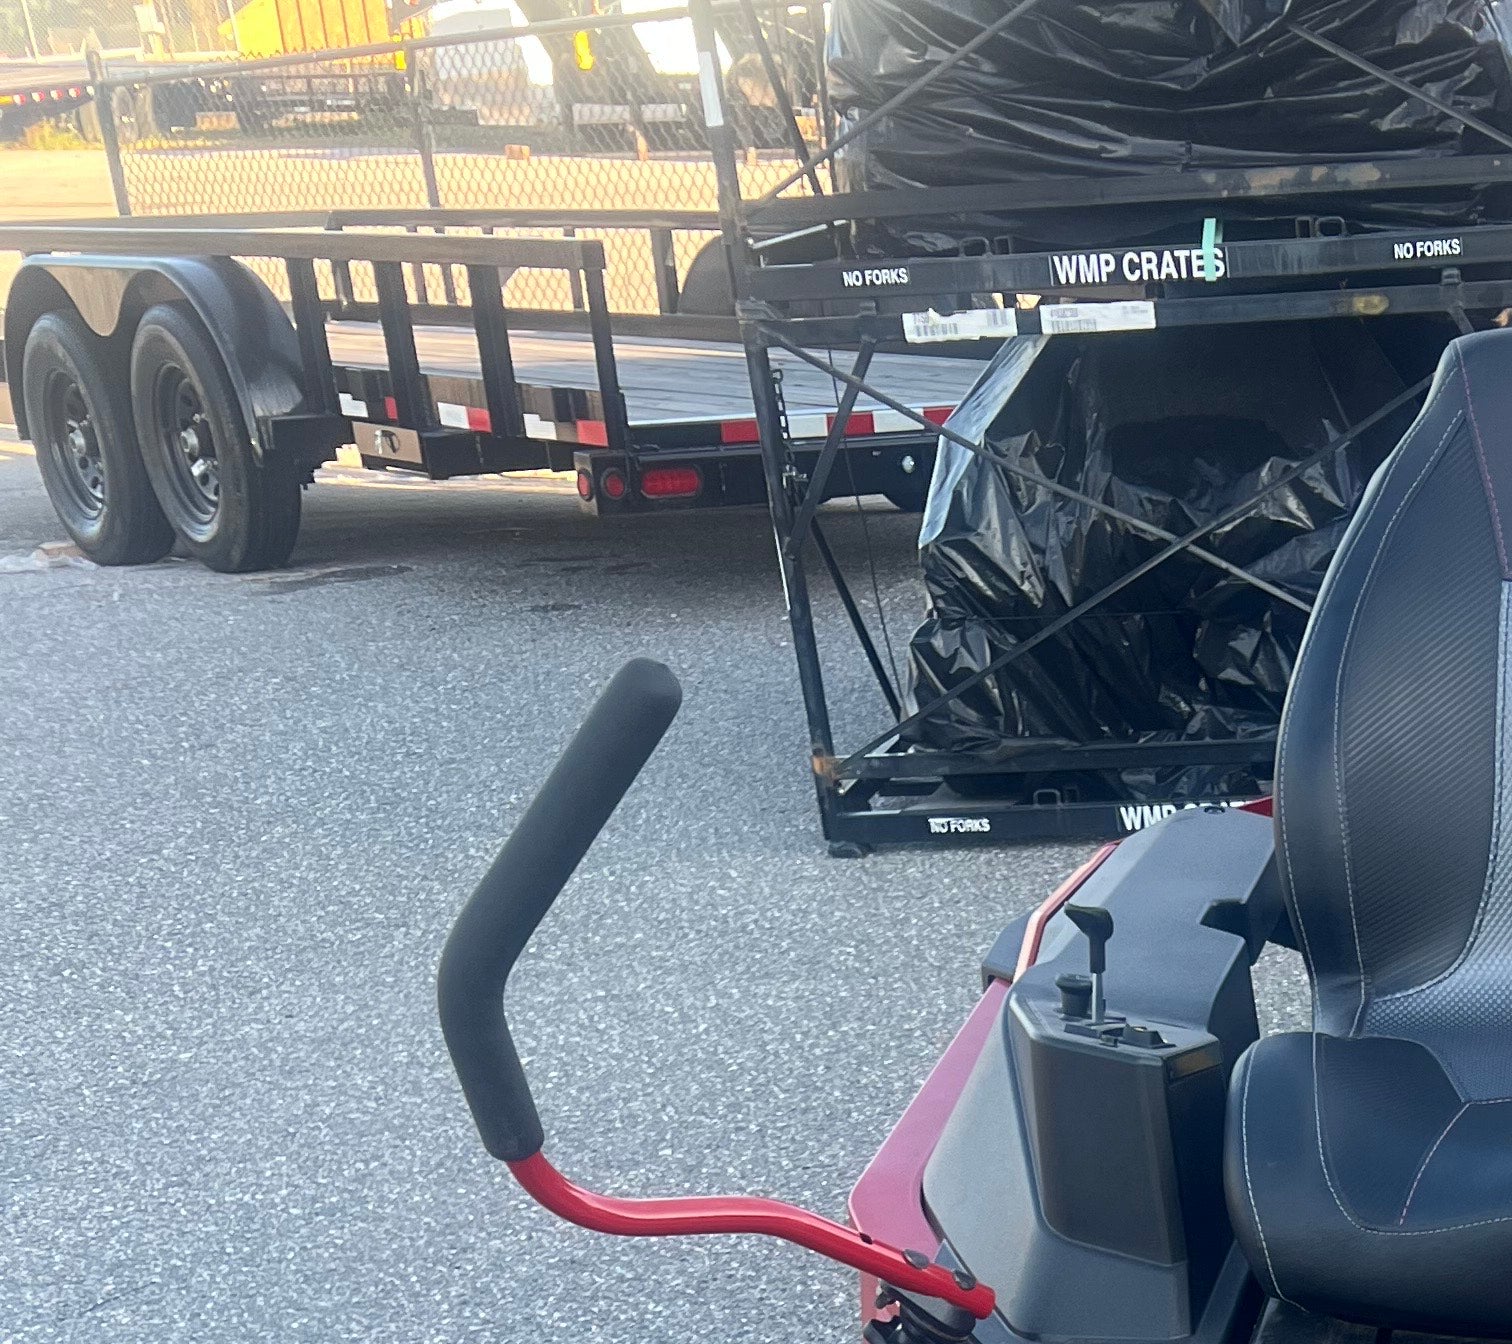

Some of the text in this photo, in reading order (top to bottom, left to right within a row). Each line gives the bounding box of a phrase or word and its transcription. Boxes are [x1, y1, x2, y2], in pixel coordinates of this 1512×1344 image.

[1393, 238, 1461, 259] NO FORKS
[1052, 247, 1226, 285] WMP CRATES
[842, 267, 909, 287] NO FORKS
[949, 818, 991, 833] FORKS
